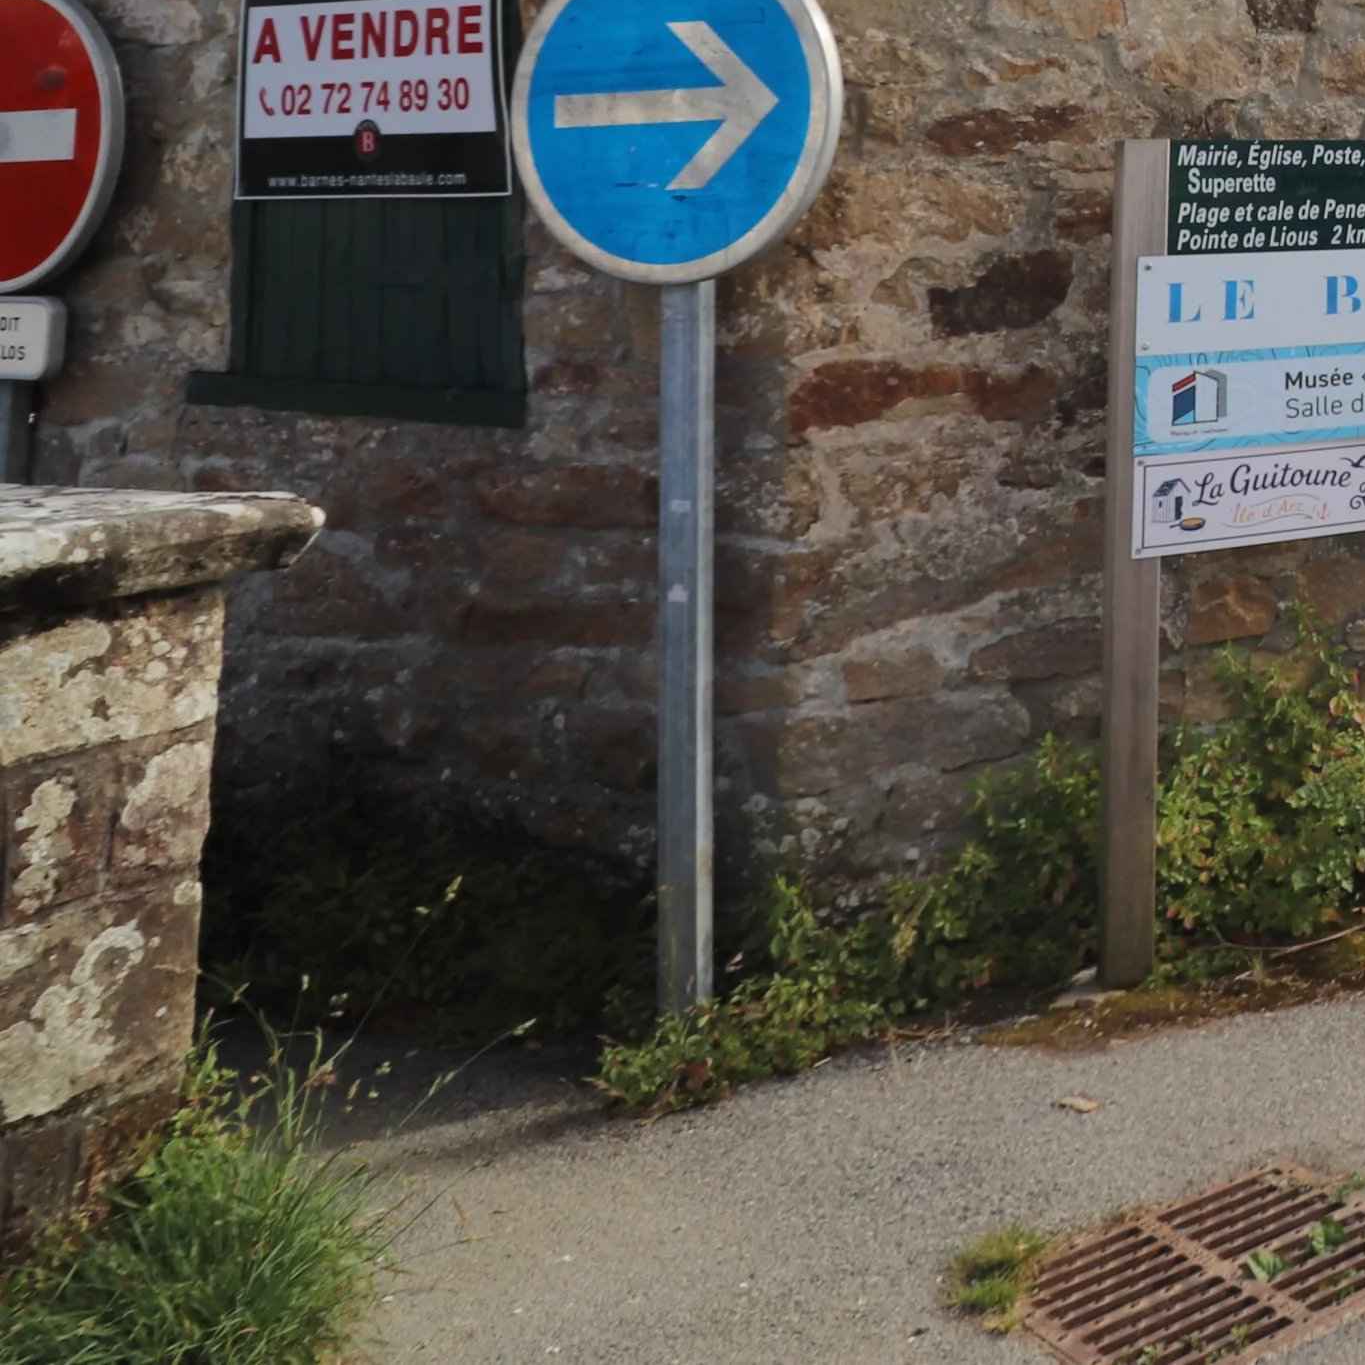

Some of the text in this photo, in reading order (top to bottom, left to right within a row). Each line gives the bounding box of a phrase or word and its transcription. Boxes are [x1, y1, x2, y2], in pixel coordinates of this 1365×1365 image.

[252, 5, 484, 64] A VENDRE
[281, 77, 470, 116] 02 72 74 89 30
[1177, 139, 1365, 171] Mairie, Église, Poste,
[1187, 167, 1276, 198] Superette
[1177, 202, 1230, 228] Plage
[1234, 204, 1254, 222] et
[1257, 200, 1294, 222] cale
[1298, 199, 1320, 220] de
[1177, 229, 1238, 251] Pointe
[1243, 227, 1265, 248] de
[1269, 225, 1318, 247] Lious
[1330, 225, 1343, 245] 2
[1167, 279, 1256, 323] LE
[1285, 368, 1354, 391] Musée
[1285, 396, 1343, 419] Salle
[1192, 463, 1352, 506] La Guitoune
